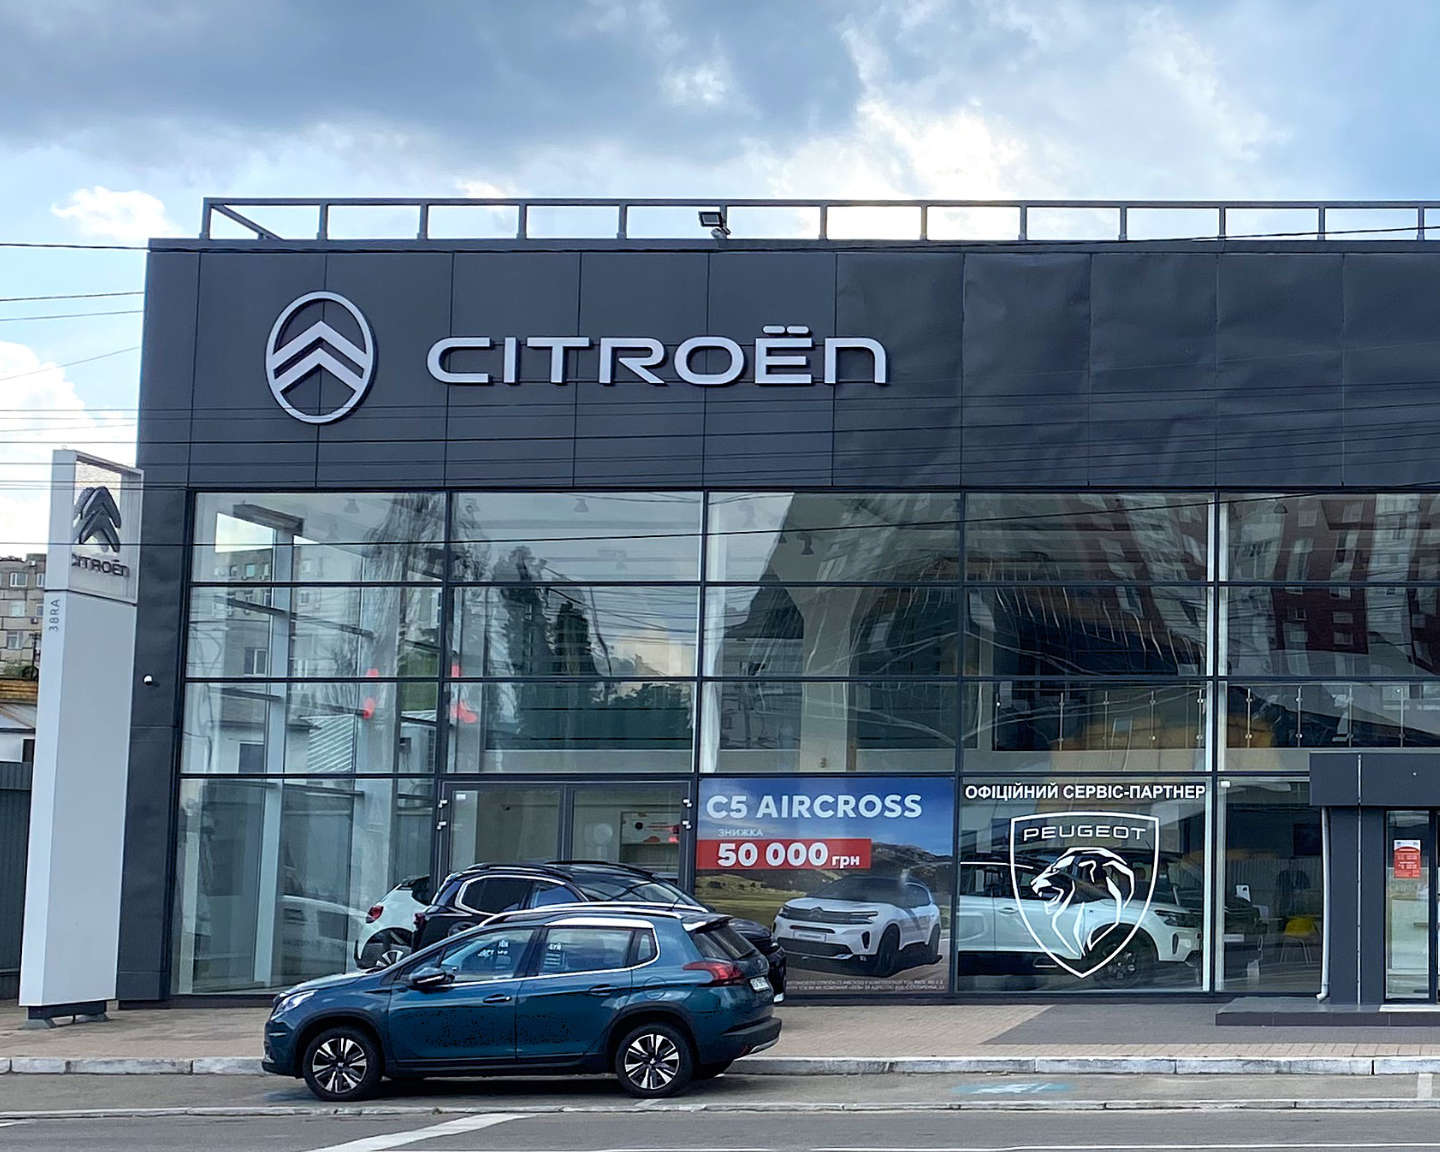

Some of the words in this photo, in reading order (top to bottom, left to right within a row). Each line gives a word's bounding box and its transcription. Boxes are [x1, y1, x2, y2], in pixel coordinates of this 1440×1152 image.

[426, 325, 888, 384] CITROËN
[965, 782, 1058, 801] ОФІЦІЙНИЙ
[1063, 785, 1206, 800] СЕРВІС-ПАРТНЕР
[706, 795, 748, 819] C5
[756, 794, 923, 819] AIRCROSS
[718, 829, 764, 837] ЗНИЖКА
[1023, 825, 1146, 842] PEUGEOT
[717, 842, 758, 867] 50
[765, 842, 829, 867] 000
[831, 856, 860, 869] грн
